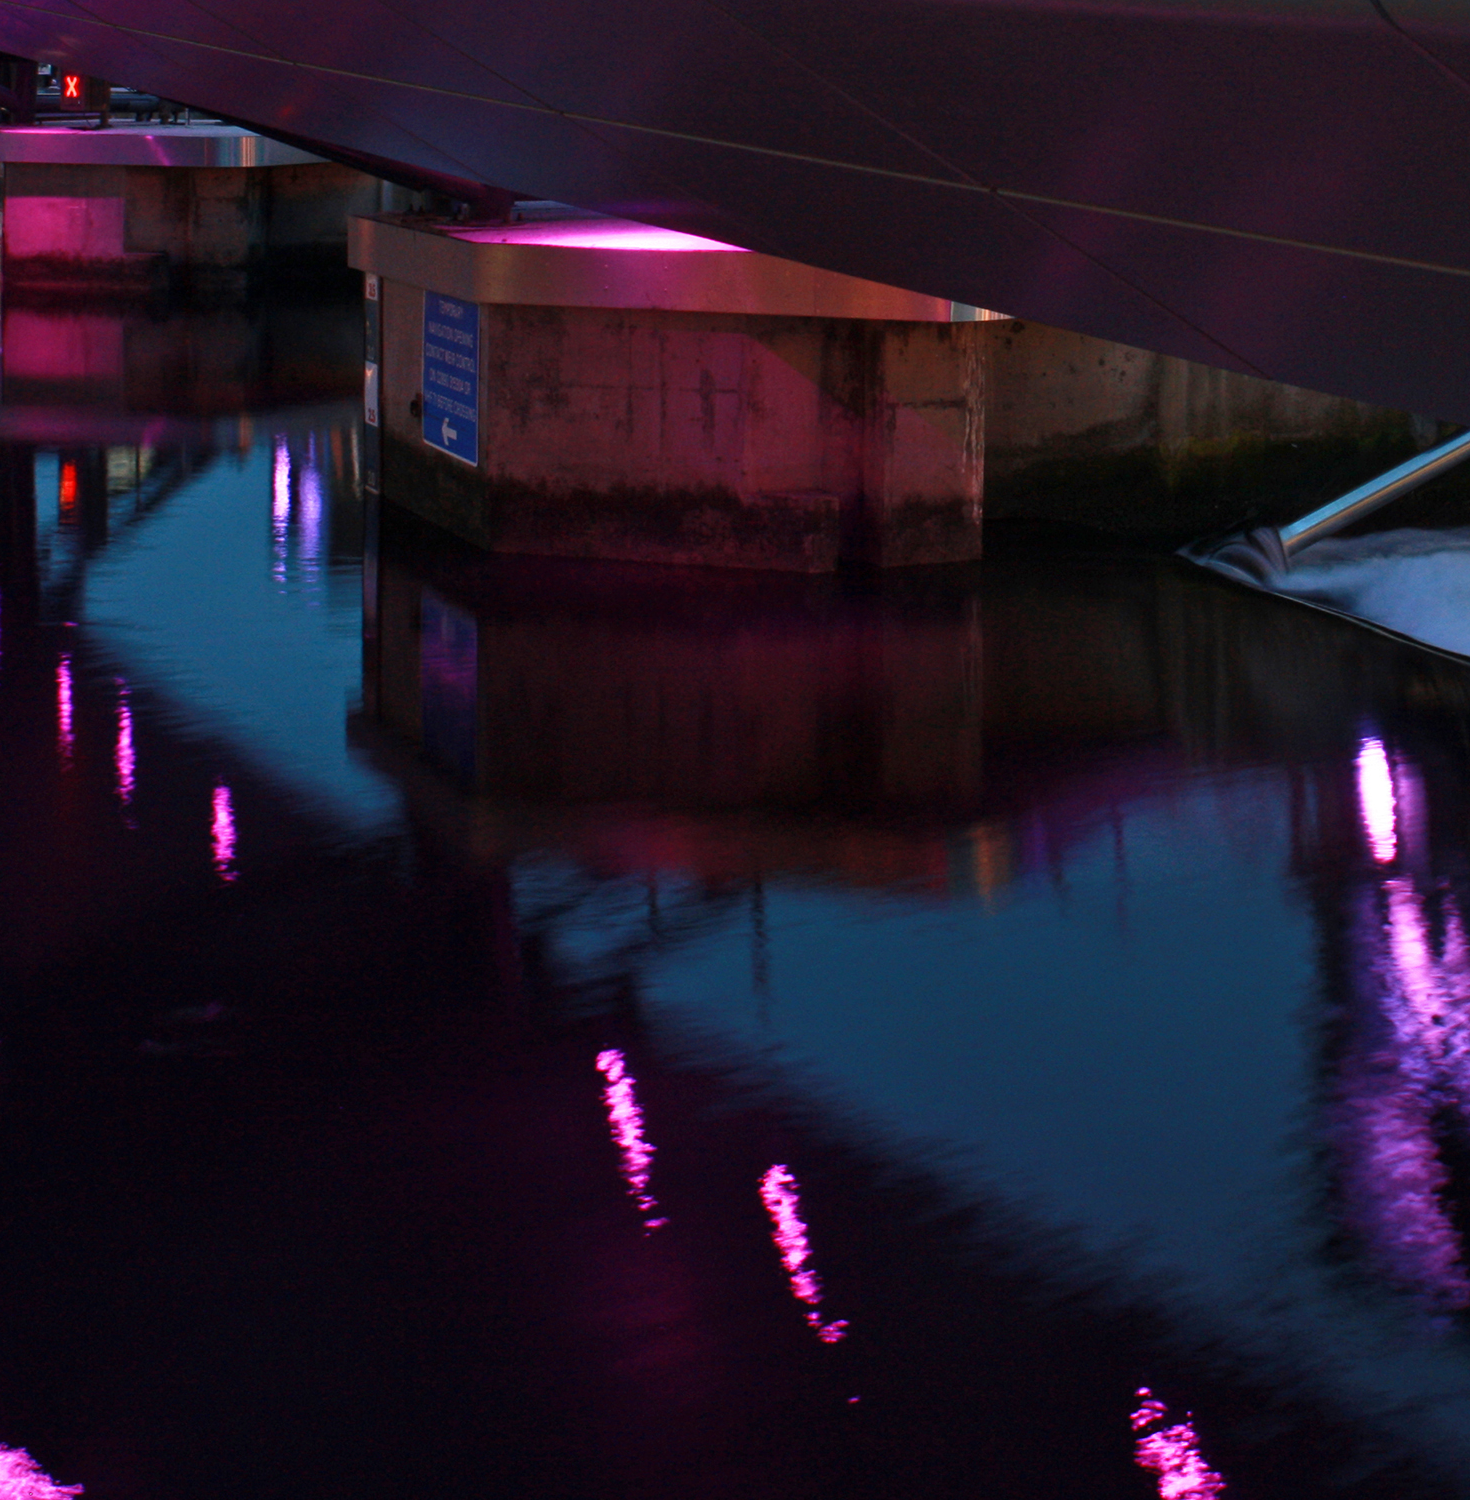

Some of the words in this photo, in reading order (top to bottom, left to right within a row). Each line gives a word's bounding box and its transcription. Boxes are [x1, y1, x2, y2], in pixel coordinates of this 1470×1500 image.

[427, 320, 453, 341] NAVIGATION
[453, 328, 473, 347] OPENING
[425, 343, 445, 362] CONTACT
[444, 349, 455, 365] WEIR
[455, 353, 476, 373] CONTROL
[453, 400, 476, 422] CROSSING
